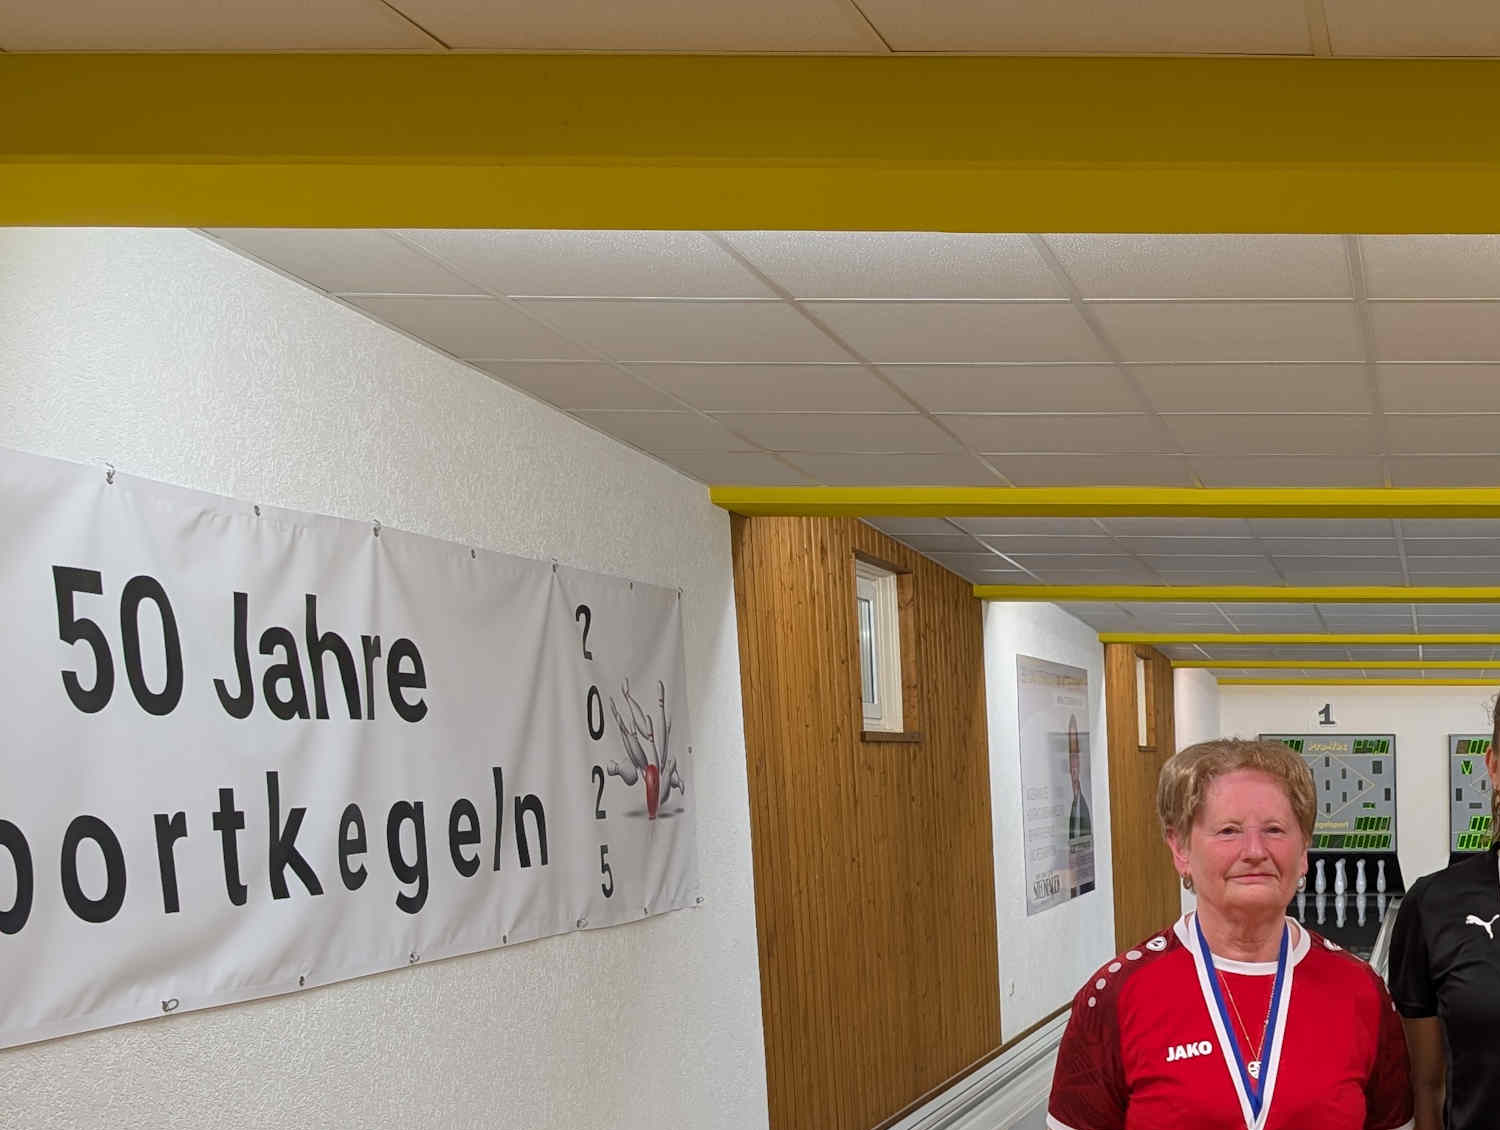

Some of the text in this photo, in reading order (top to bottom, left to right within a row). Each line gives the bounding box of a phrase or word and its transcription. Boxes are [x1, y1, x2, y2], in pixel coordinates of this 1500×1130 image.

[53, 565, 429, 723] 50 Jahre
[1318, 703, 1336, 726] 1
[1165, 1040, 1213, 1062] JAKO
